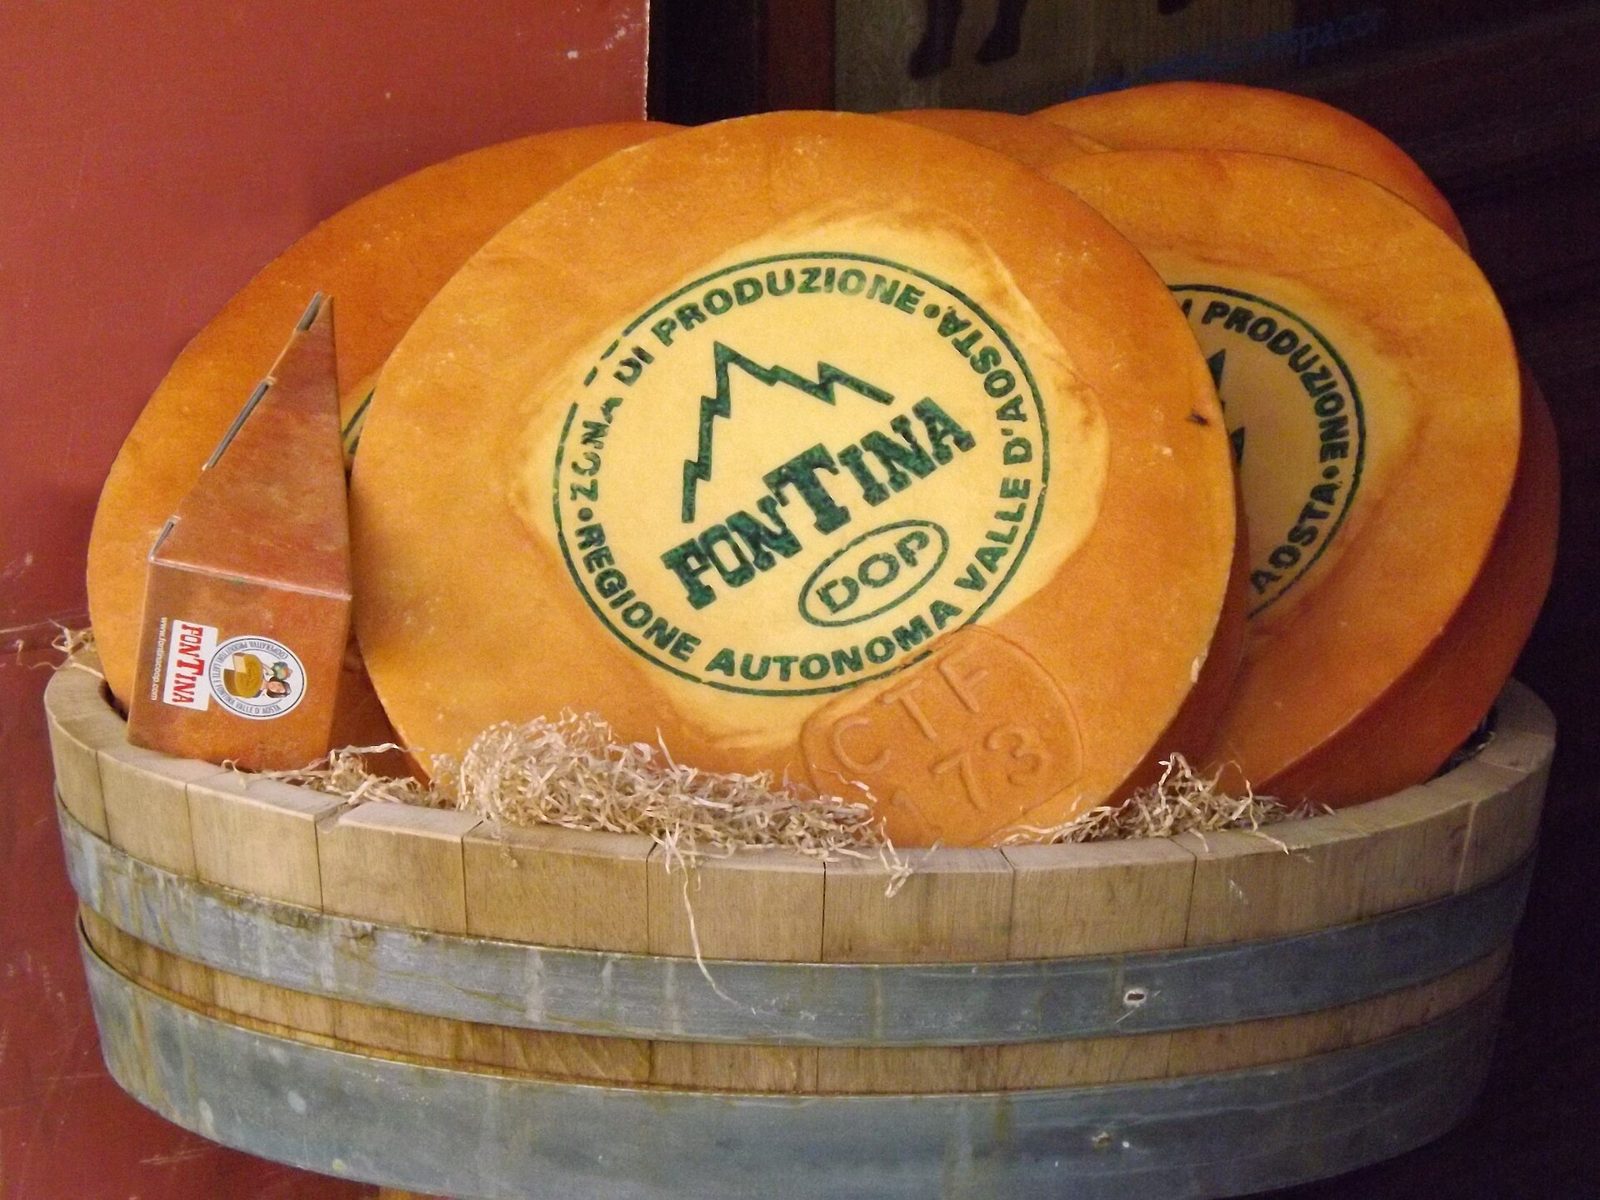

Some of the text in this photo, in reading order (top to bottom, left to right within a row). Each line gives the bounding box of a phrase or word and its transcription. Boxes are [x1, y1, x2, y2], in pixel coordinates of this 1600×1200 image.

[570, 397, 623, 501] ZONA
[651, 266, 925, 347] PRODUZIONE
[1201, 300, 1349, 464] PRODUZIONE
[575, 306, 1033, 682] REGIONE AUTONOMA VALLE D'AOSTA
[660, 396, 976, 610] FONTINA
[1249, 481, 1340, 595] AOSTA
[815, 530, 930, 615] DOP
[172, 624, 205, 702] FONTINA
[831, 640, 989, 774] CTF
